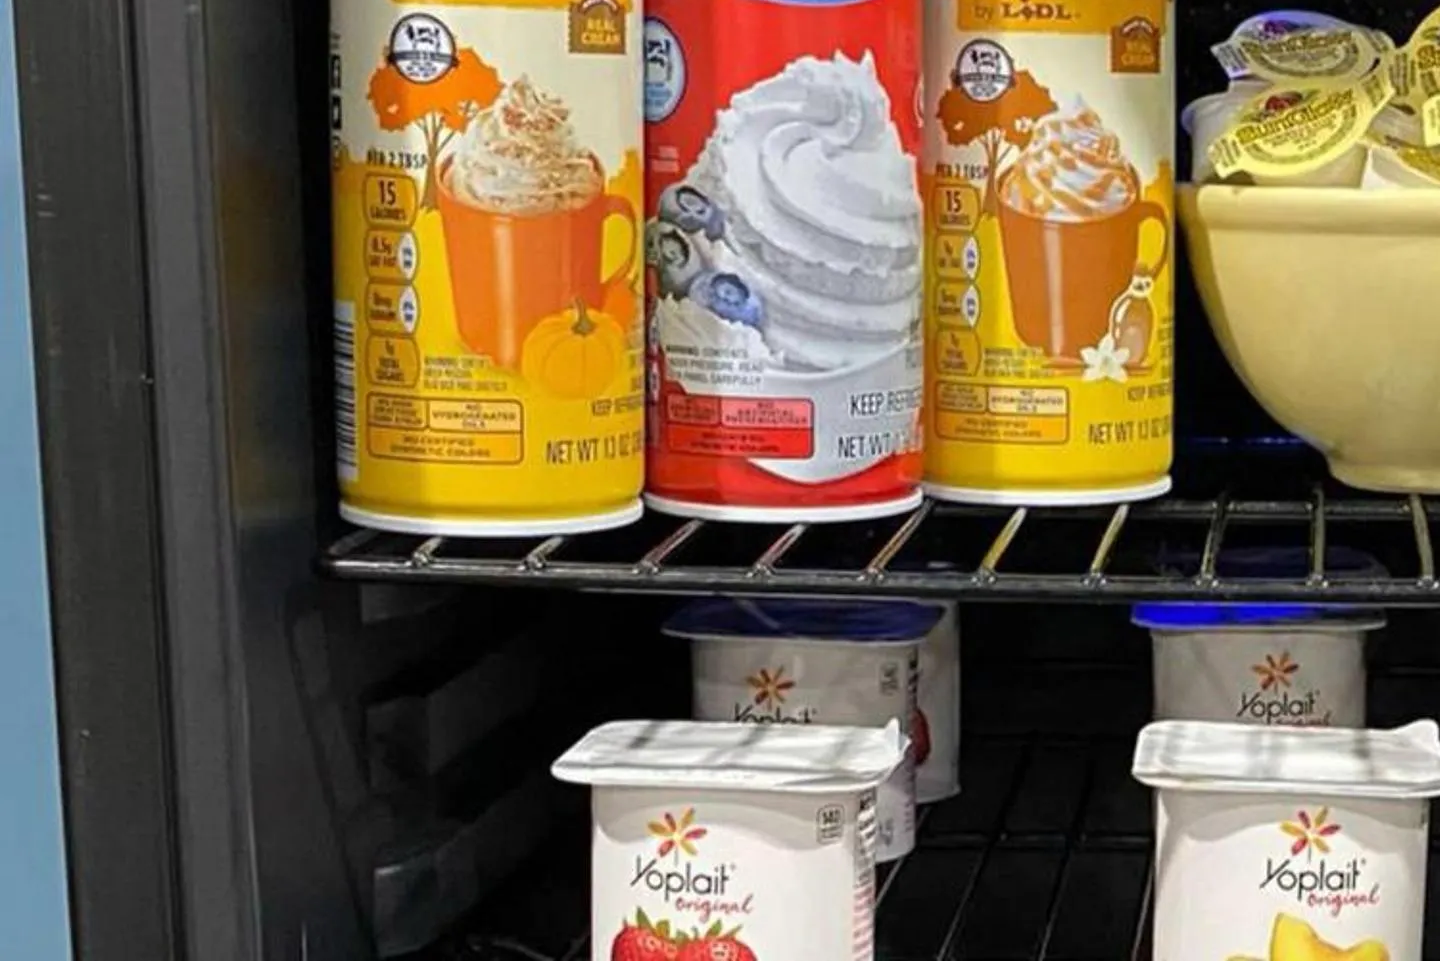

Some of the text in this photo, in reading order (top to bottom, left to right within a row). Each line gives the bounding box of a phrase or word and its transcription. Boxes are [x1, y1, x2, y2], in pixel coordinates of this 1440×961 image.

[973, 3, 995, 22] by
[378, 179, 397, 206] 15
[946, 190, 961, 213] 15
[850, 391, 885, 417] KEEP
[1088, 422, 1113, 445] NET
[1115, 420, 1134, 443] WT
[546, 438, 574, 465] NET
[577, 437, 600, 463] WT
[838, 435, 866, 460] NET
[1237, 690, 1317, 726] Yoplait
[630, 856, 732, 902] Yoplait
[1260, 857, 1361, 901] Yoplait
